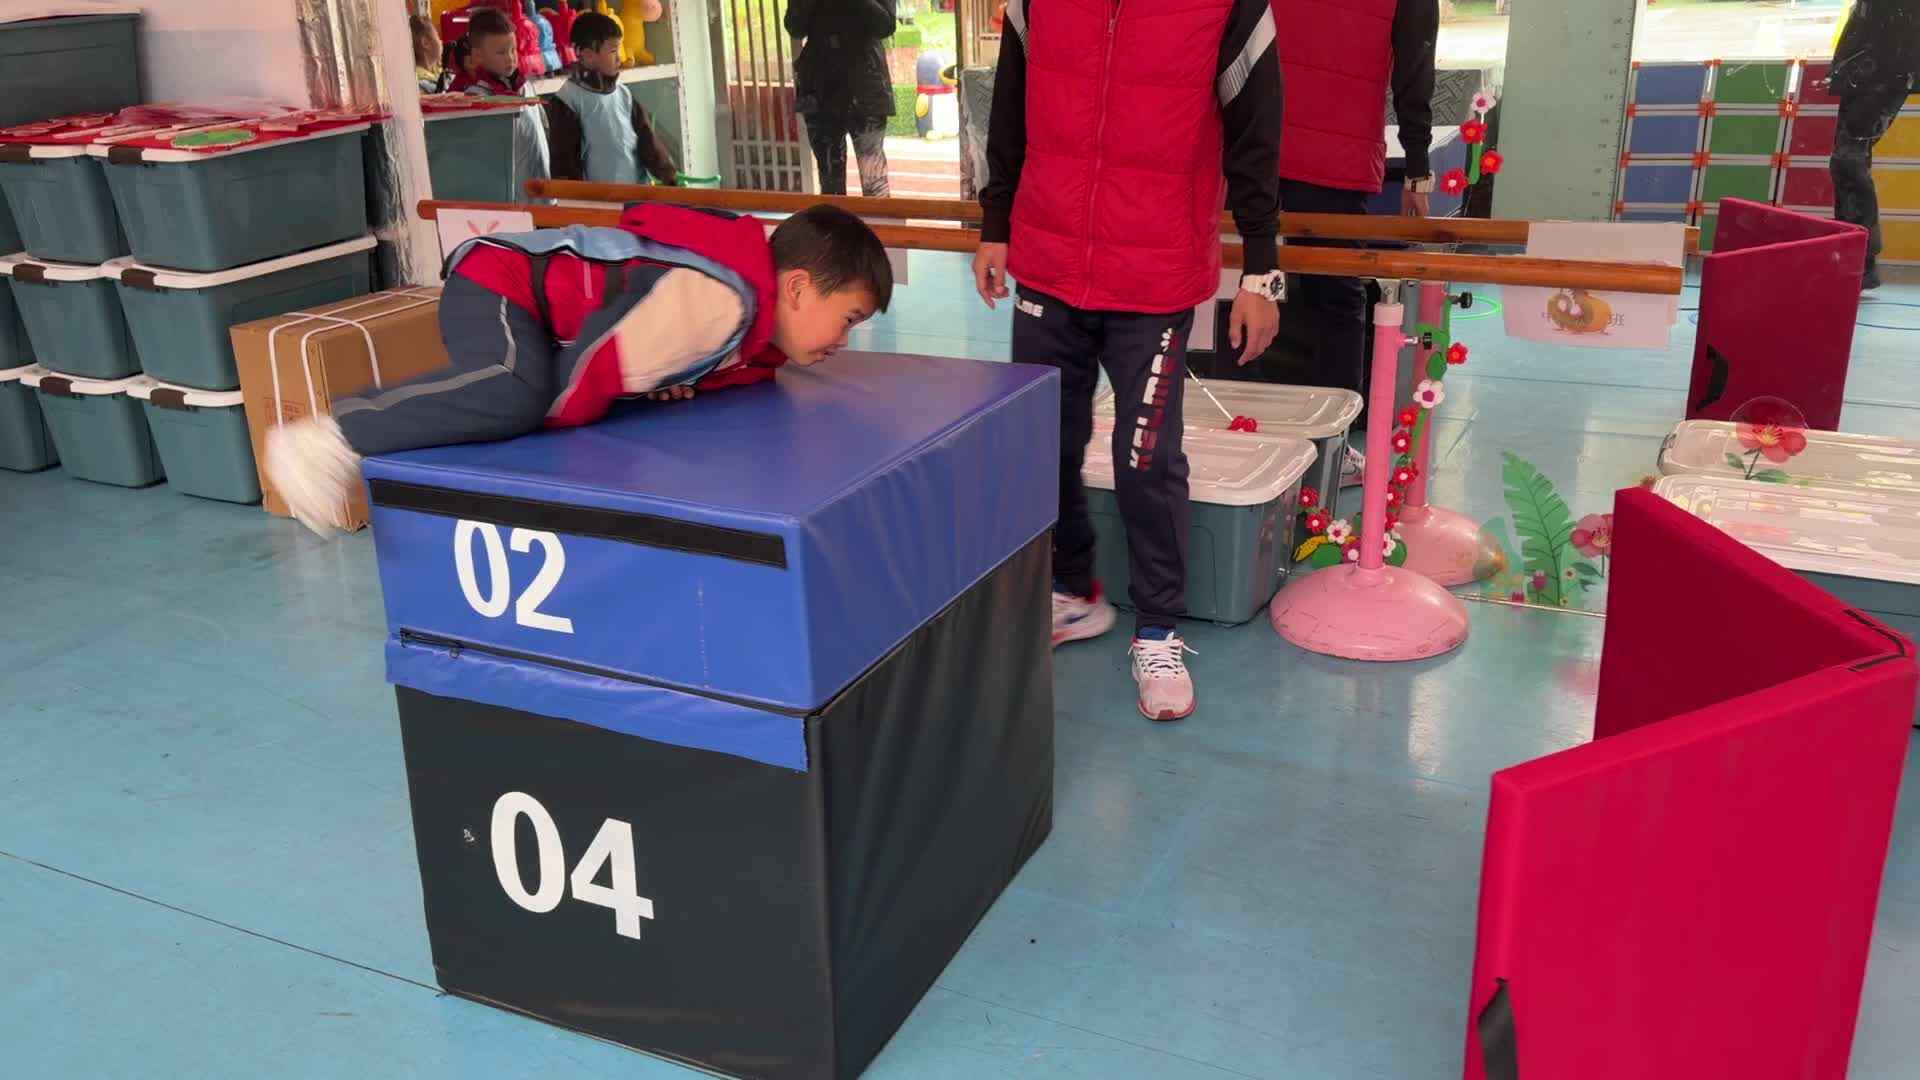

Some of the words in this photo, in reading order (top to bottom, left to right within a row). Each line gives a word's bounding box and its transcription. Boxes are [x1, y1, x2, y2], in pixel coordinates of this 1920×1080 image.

[1129, 353, 1178, 471] KELME
[454, 518, 574, 634] 02
[491, 791, 655, 940] 04
